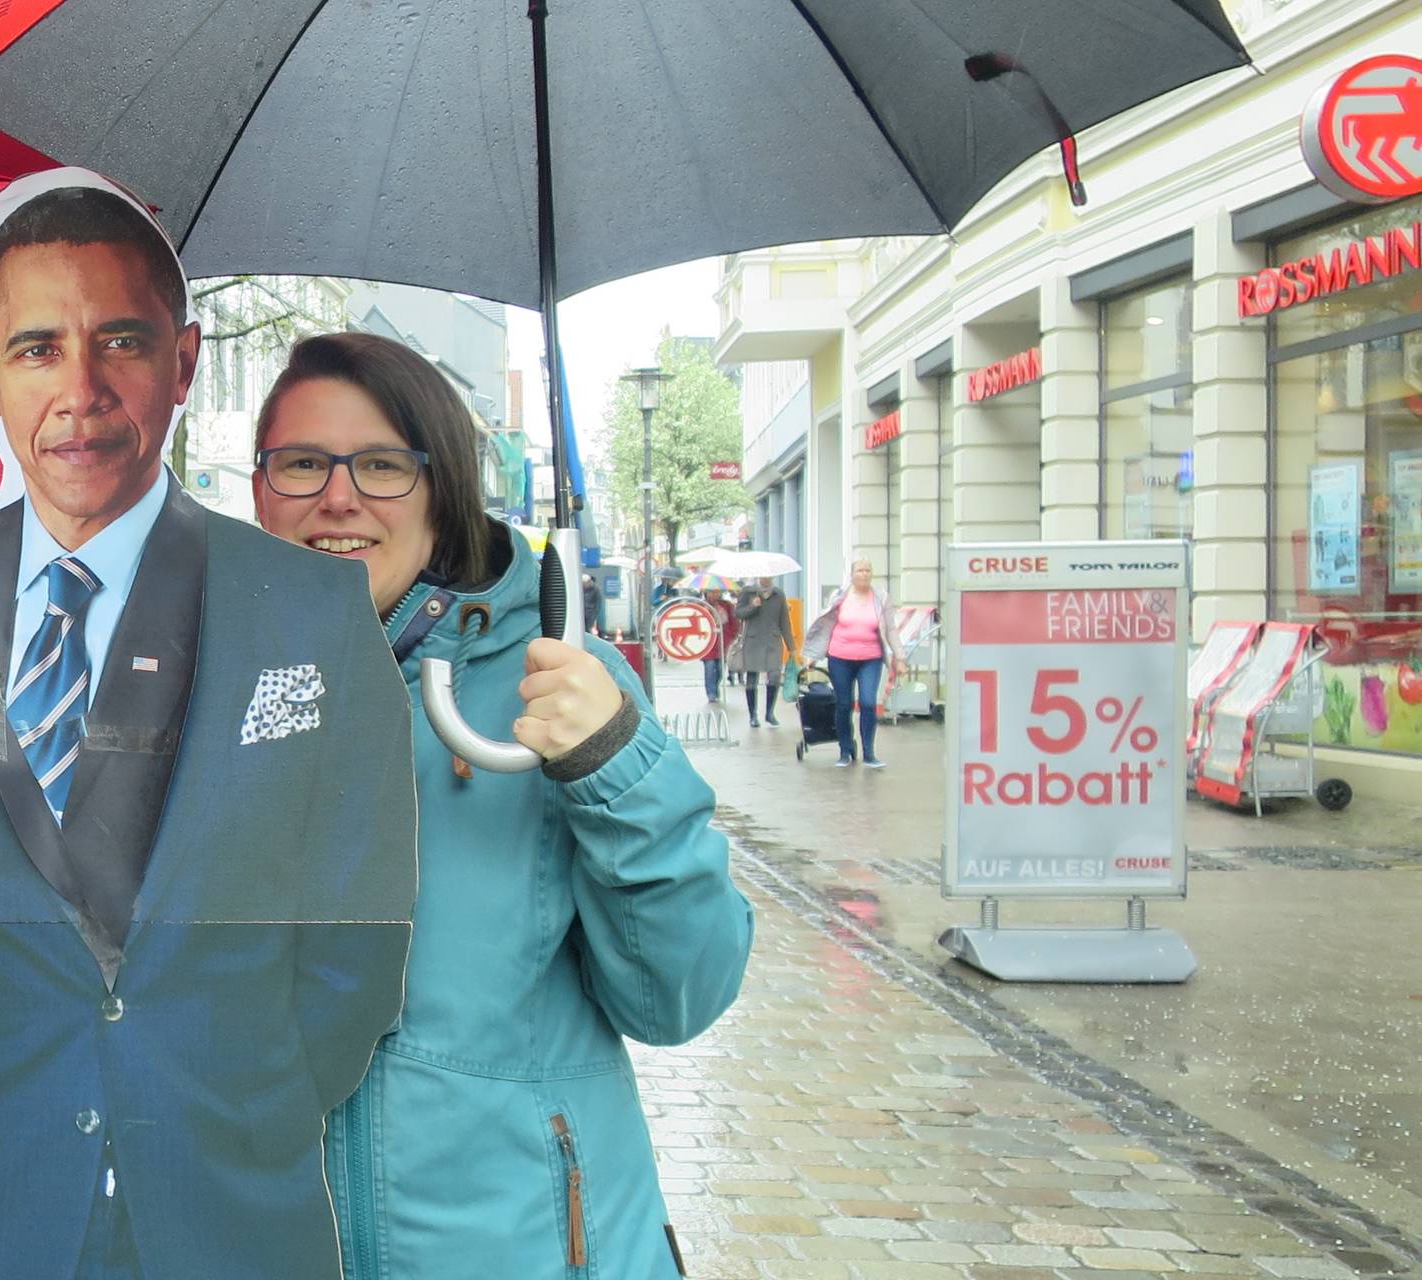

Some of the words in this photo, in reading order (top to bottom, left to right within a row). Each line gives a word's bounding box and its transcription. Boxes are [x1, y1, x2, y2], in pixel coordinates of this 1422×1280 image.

[1237, 222, 1422, 318] ROSSMANN
[969, 556, 1049, 574] CRUSE
[1069, 563, 1113, 571] TOM
[1117, 562, 1179, 570] TAILOR
[1047, 615, 1171, 640] FRIENDS
[963, 669, 1158, 754] 15%
[964, 859, 1011, 878] AUF
[1018, 859, 1104, 877] ALLES!
[1115, 857, 1170, 869] CRUSE
